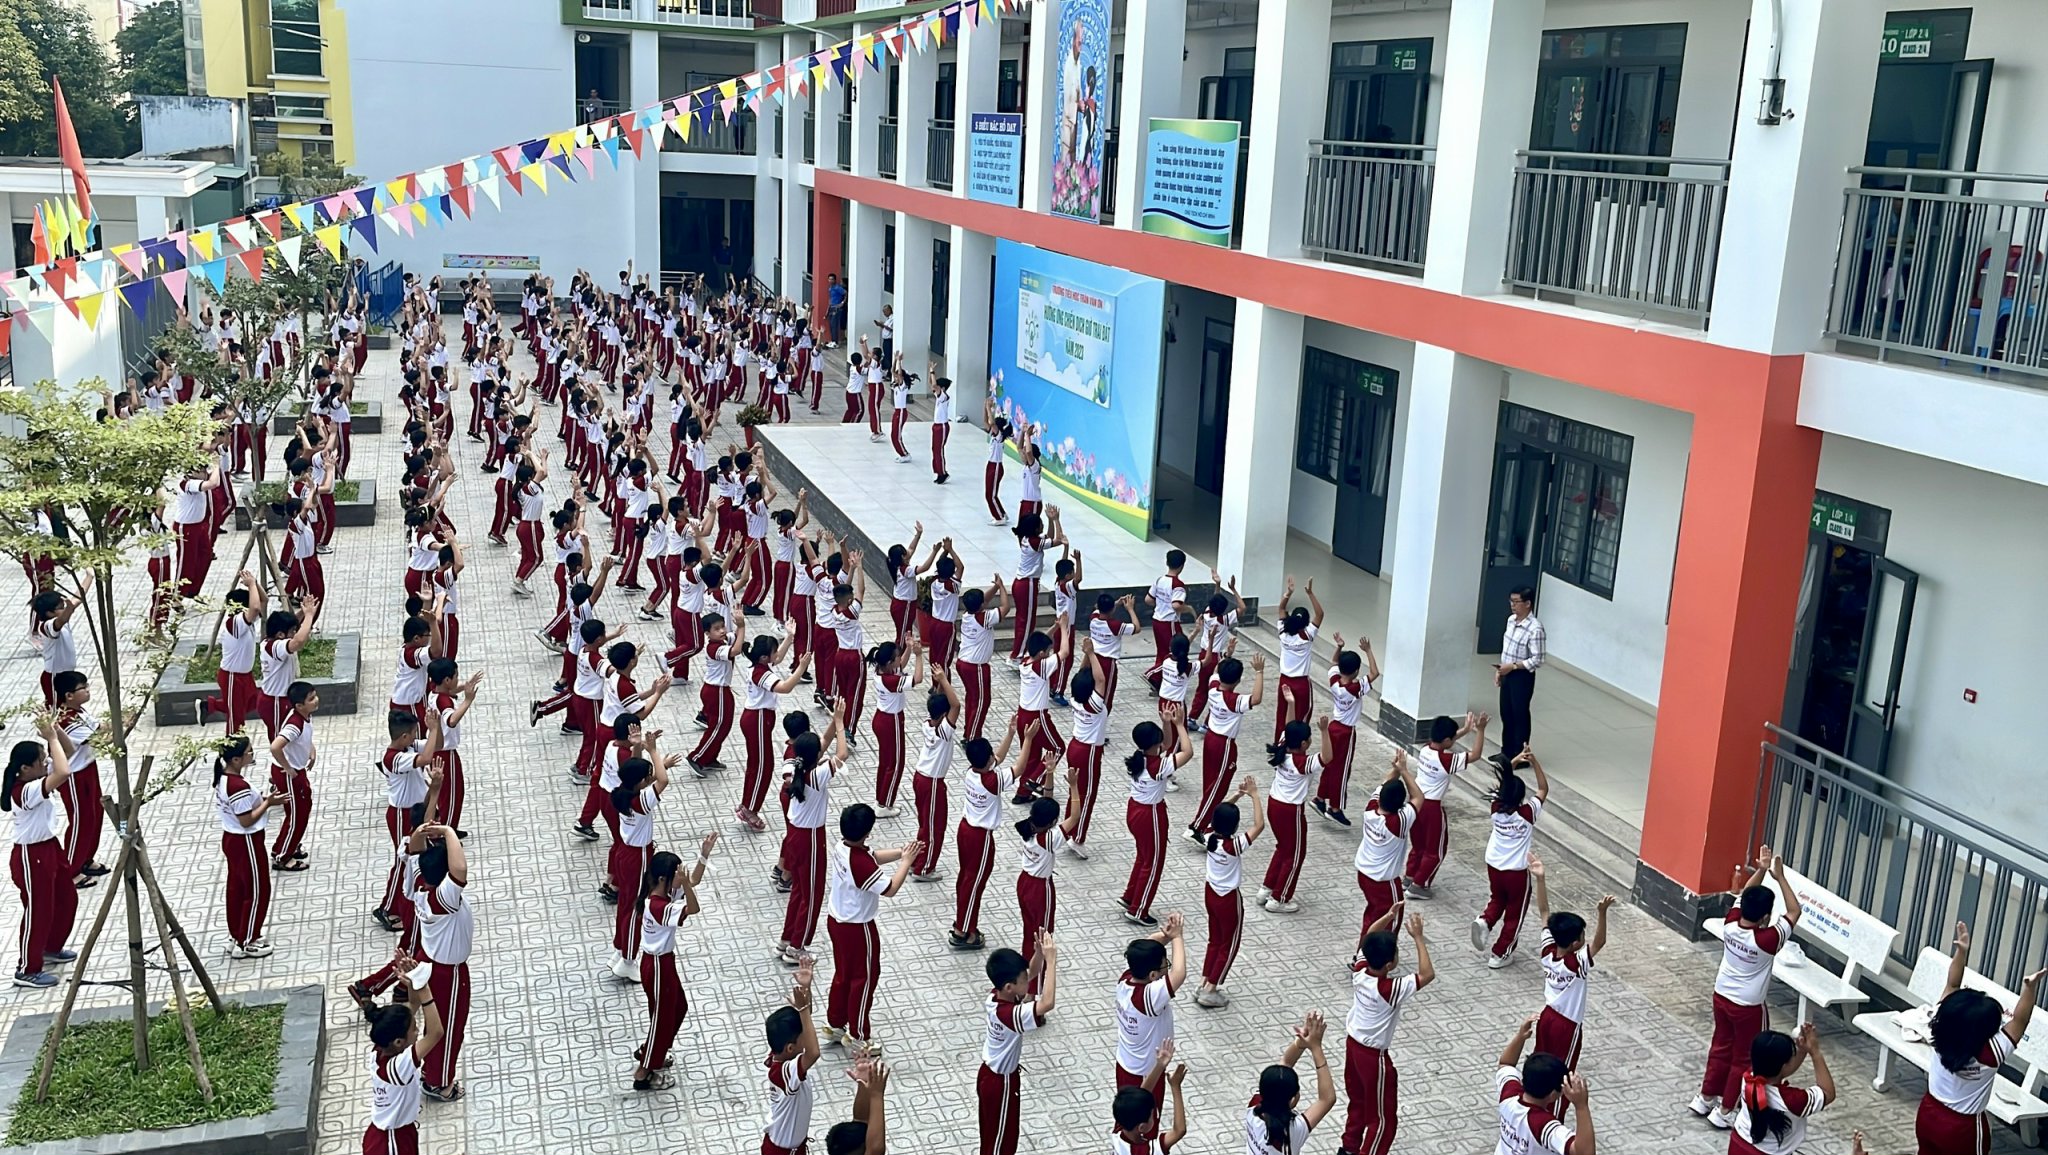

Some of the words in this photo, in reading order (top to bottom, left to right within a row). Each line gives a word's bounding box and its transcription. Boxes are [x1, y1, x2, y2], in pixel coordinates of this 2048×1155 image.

[1881, 38, 1897, 52] 10
[1395, 56, 1400, 67] 9
[975, 121, 978, 130] 5
[1812, 512, 1820, 526] 4
